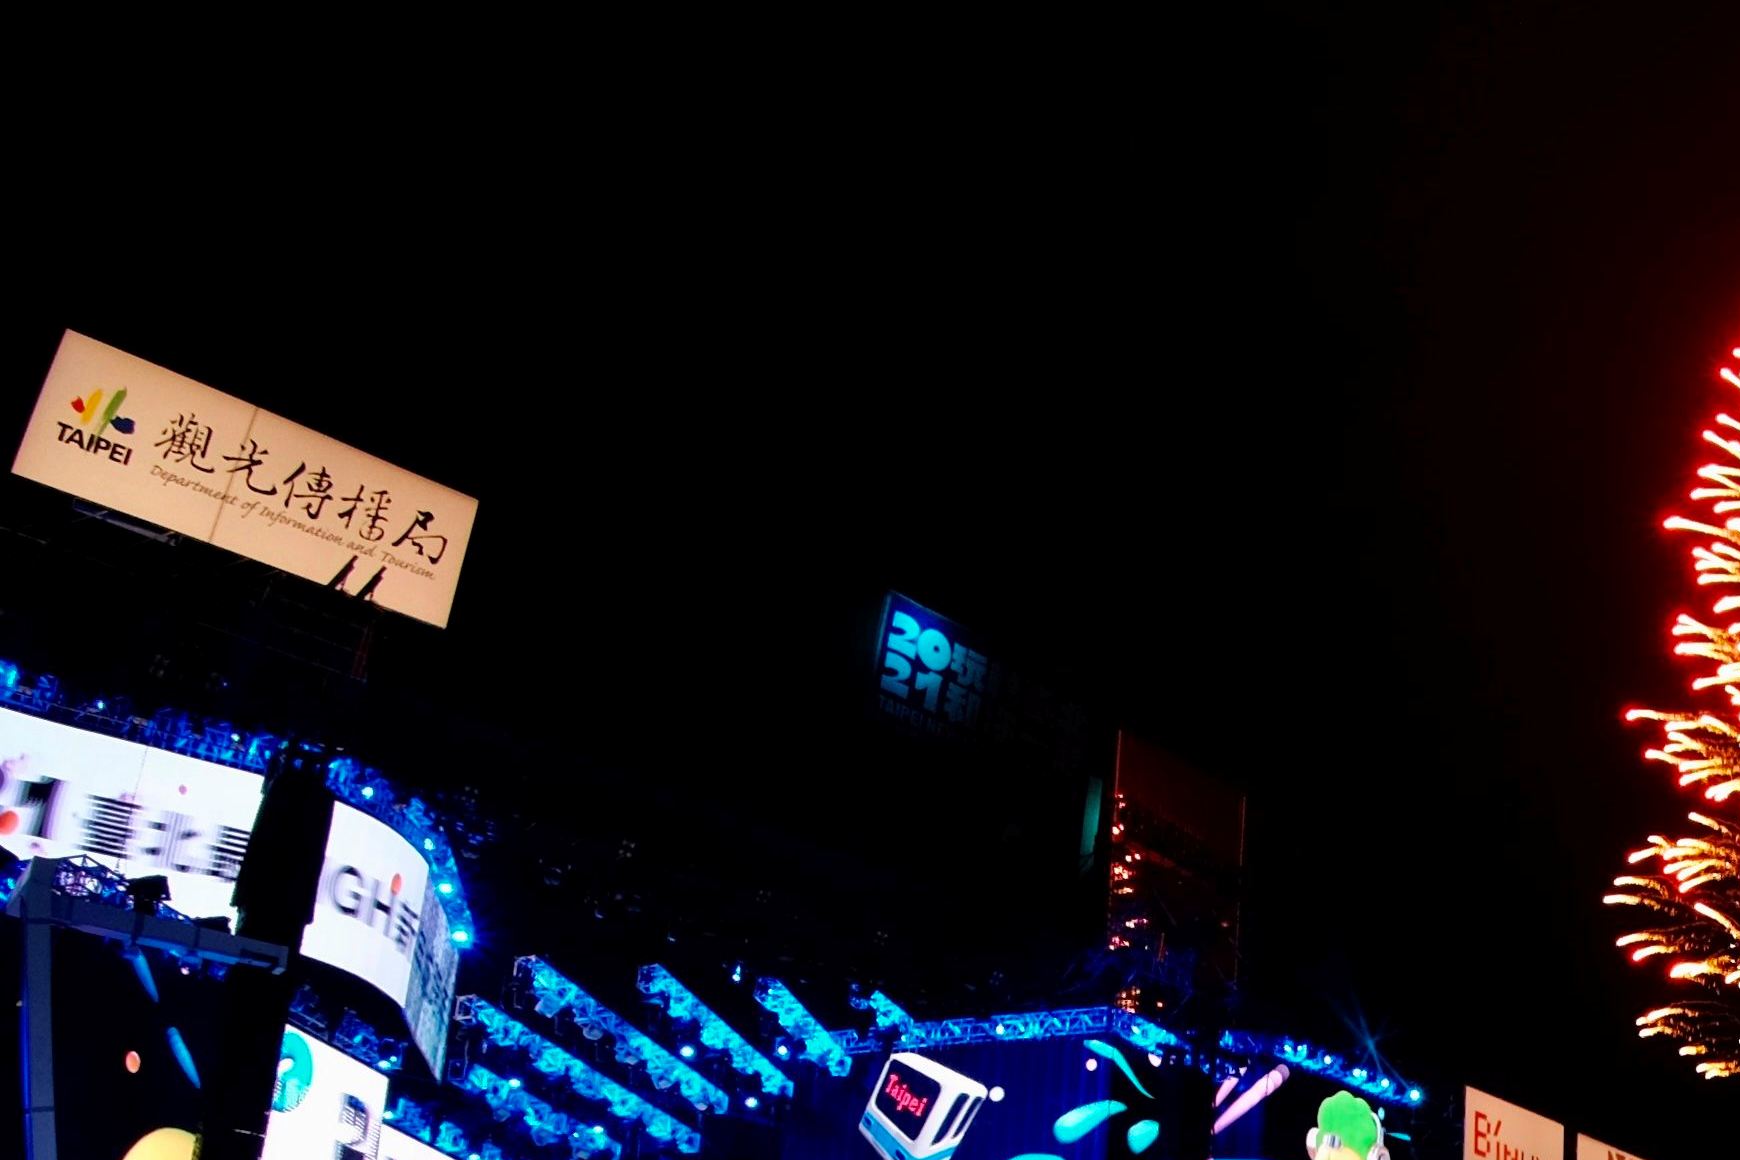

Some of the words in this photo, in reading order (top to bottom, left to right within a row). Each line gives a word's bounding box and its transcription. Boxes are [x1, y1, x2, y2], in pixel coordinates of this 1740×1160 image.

[56, 421, 133, 466] TAIPEI
[150, 464, 238, 506] Department
[241, 500, 258, 518] of
[259, 505, 344, 547] Information
[346, 540, 375, 557] and
[382, 552, 437, 580] Tourism
[154, 413, 448, 565] 觀光傳播局
[886, 1073, 928, 1118] Taipei
